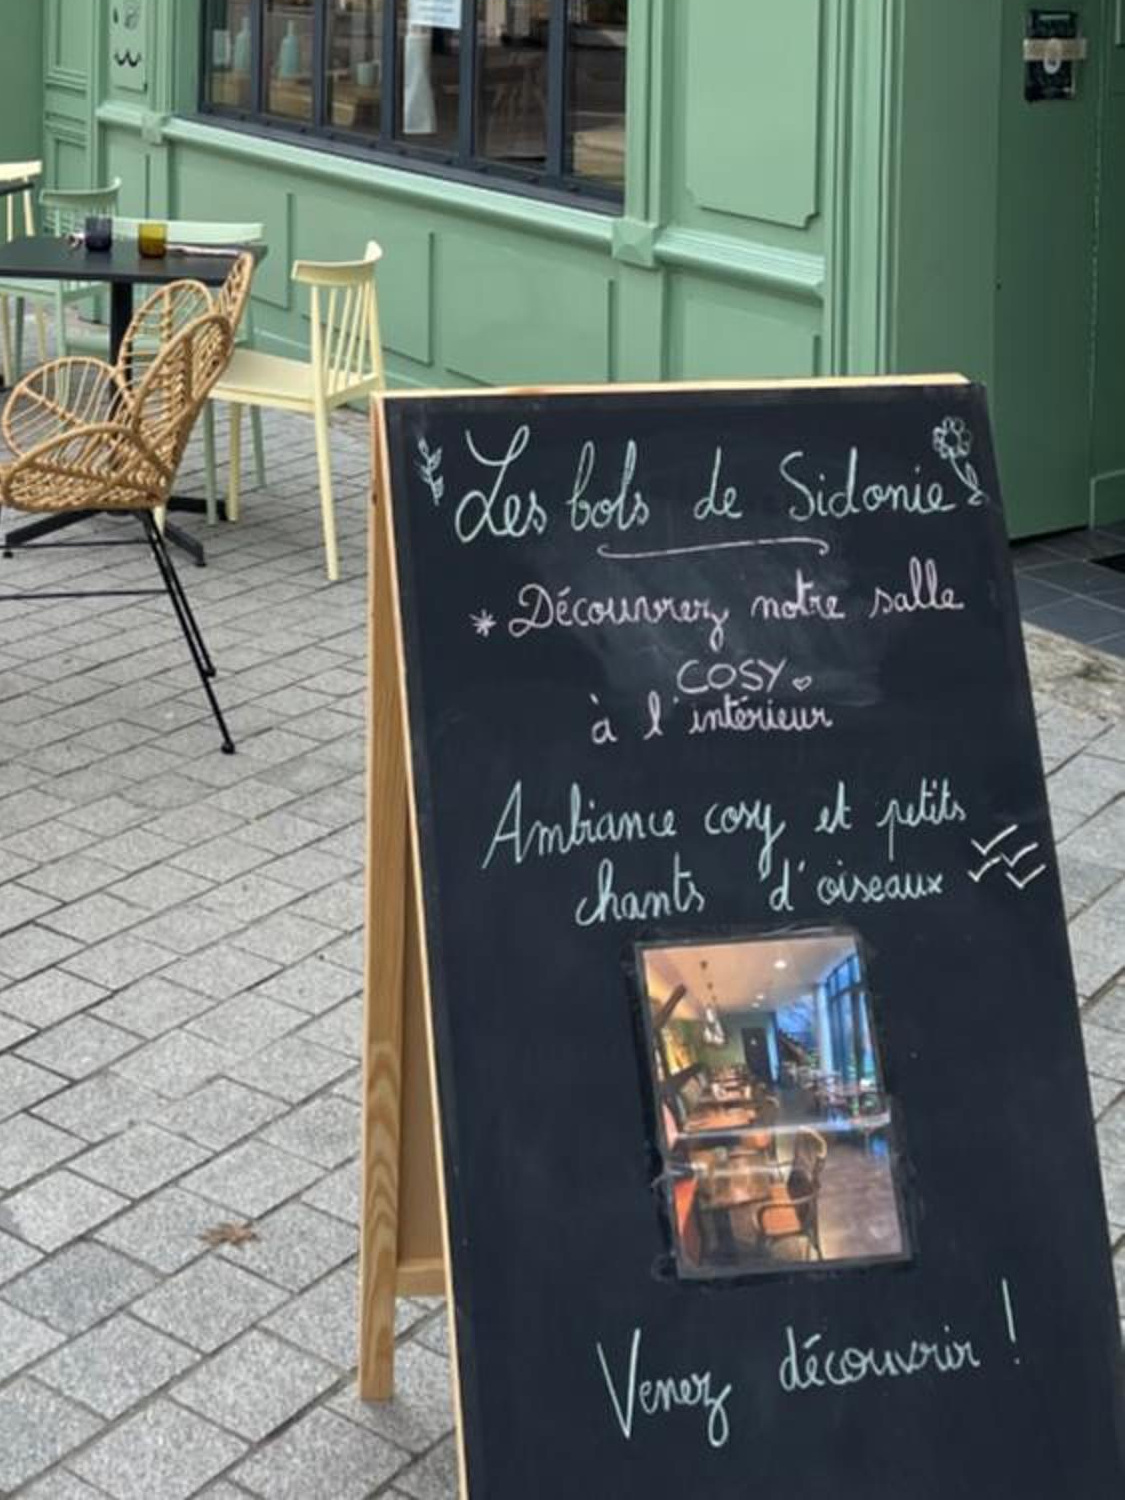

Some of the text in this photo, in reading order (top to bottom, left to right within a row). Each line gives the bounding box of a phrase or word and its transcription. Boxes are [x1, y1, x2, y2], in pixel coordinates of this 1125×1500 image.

[455, 425, 957, 544] Les bols de Sidonie
[508, 557, 965, 651] Découvrez notre salle
[589, 693, 618, 744] à
[676, 659, 787, 694] COSY
[481, 778, 968, 882] Ambiance cosy et petits
[575, 853, 706, 926] chants
[596, 1328, 733, 1449] Venez
[779, 1326, 981, 1392] découvrir
